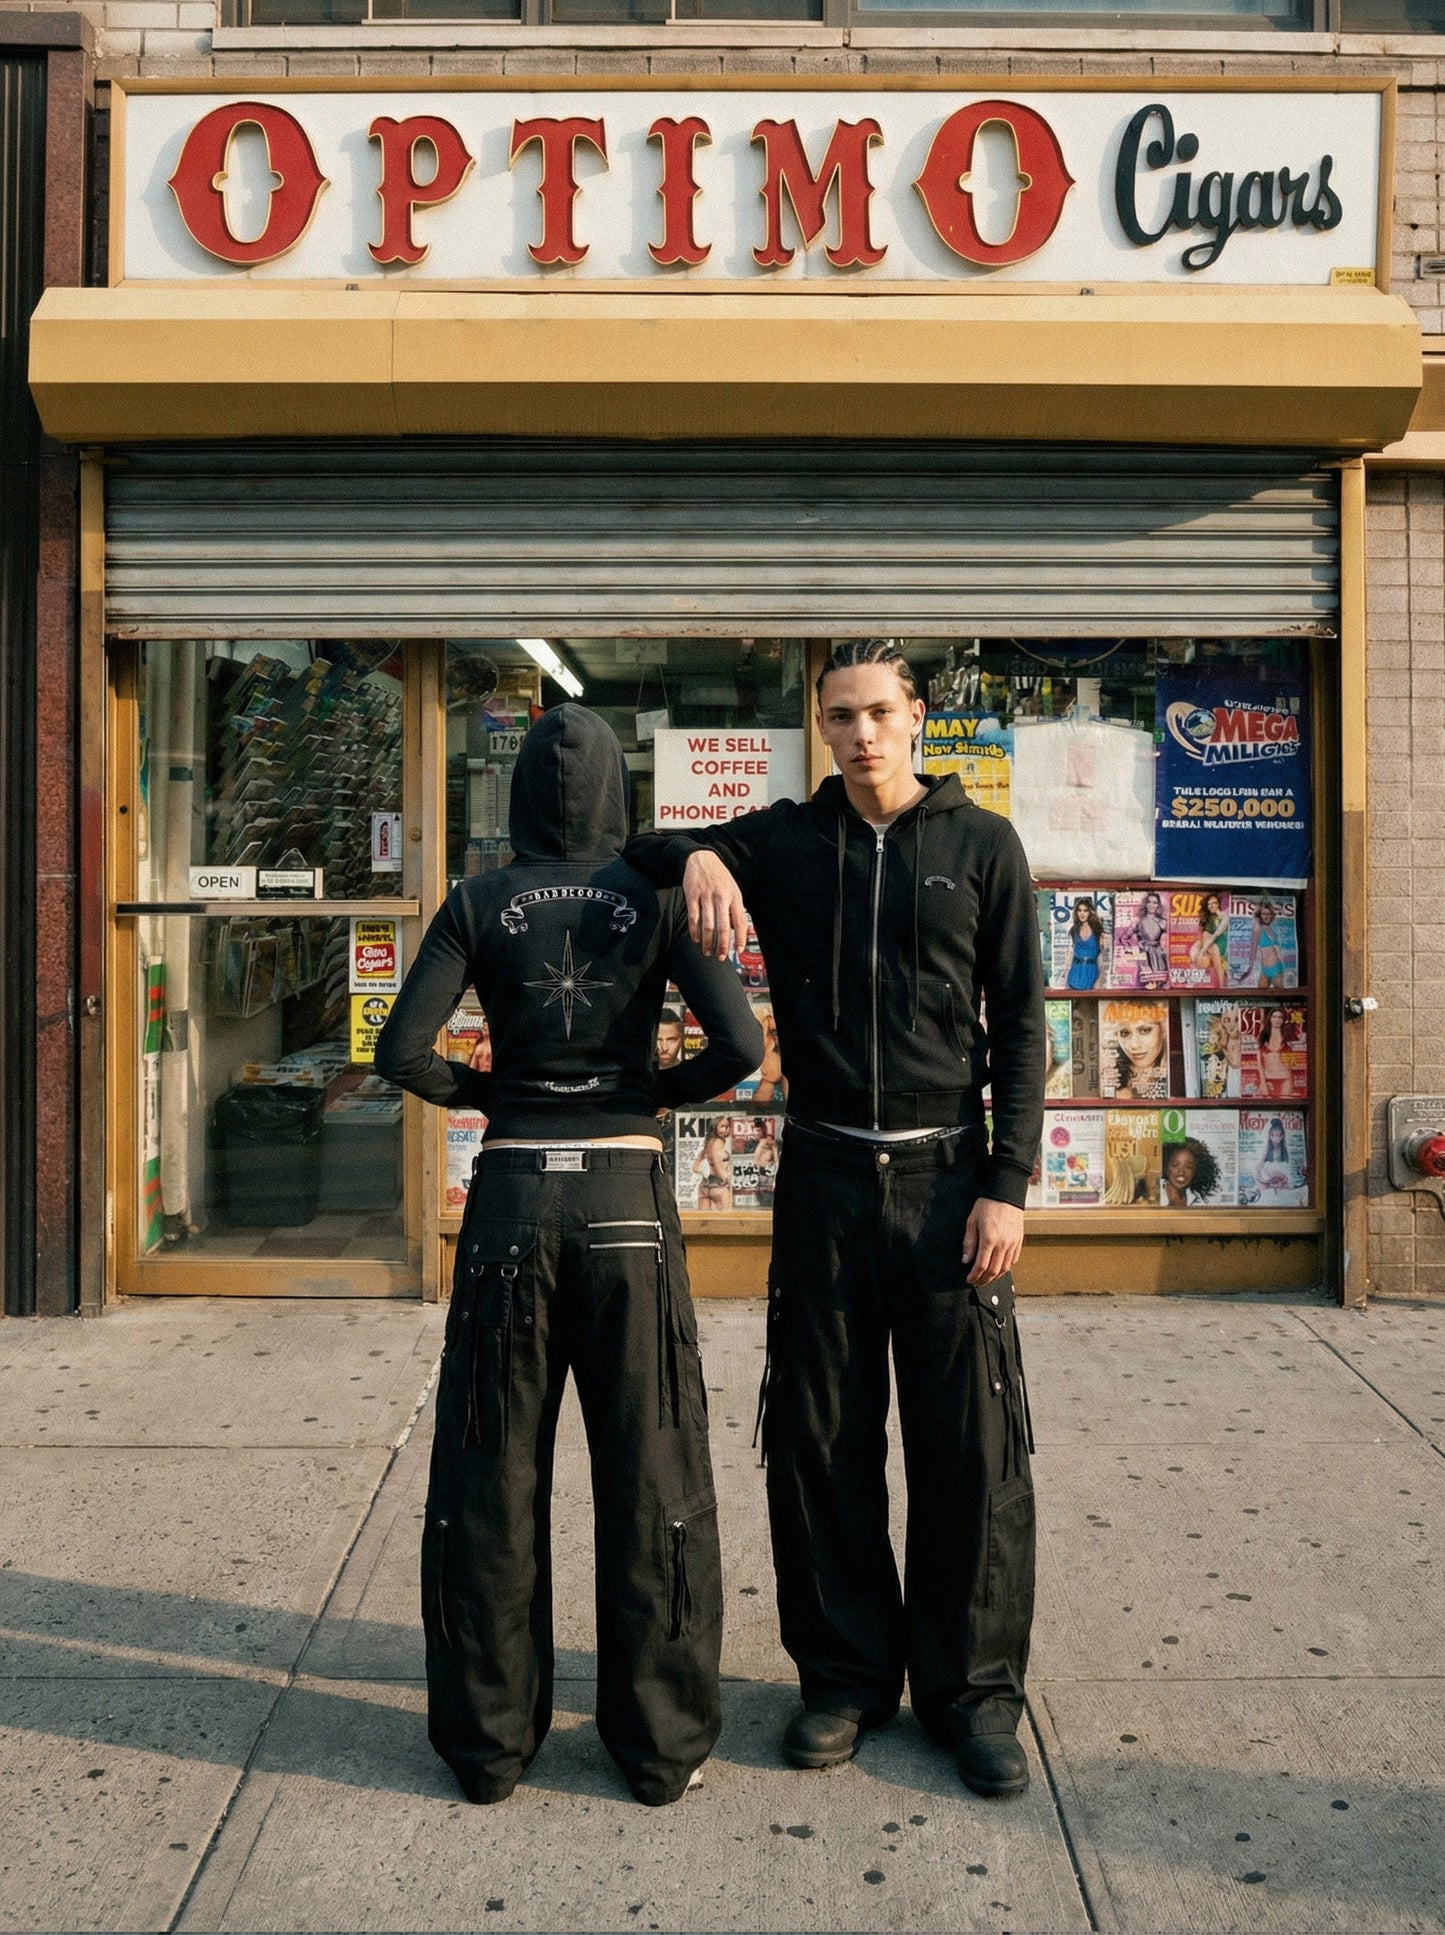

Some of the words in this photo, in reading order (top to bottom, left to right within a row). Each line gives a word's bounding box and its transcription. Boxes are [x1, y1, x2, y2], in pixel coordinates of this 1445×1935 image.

[167, 99, 1076, 269] OPTIMO
[1115, 103, 1343, 271] Cigars
[925, 718, 979, 739] MAY
[1209, 706, 1299, 743] MEGA
[687, 737, 720, 753] WE
[724, 737, 773, 753] SELL
[690, 760, 769, 775] COFFEE
[707, 783, 751, 798] AND
[659, 805, 727, 820] PHONE
[1170, 796, 1296, 820] $250,000
[197, 875, 240, 888] OPEN
[1164, 1109, 1185, 1134] O
